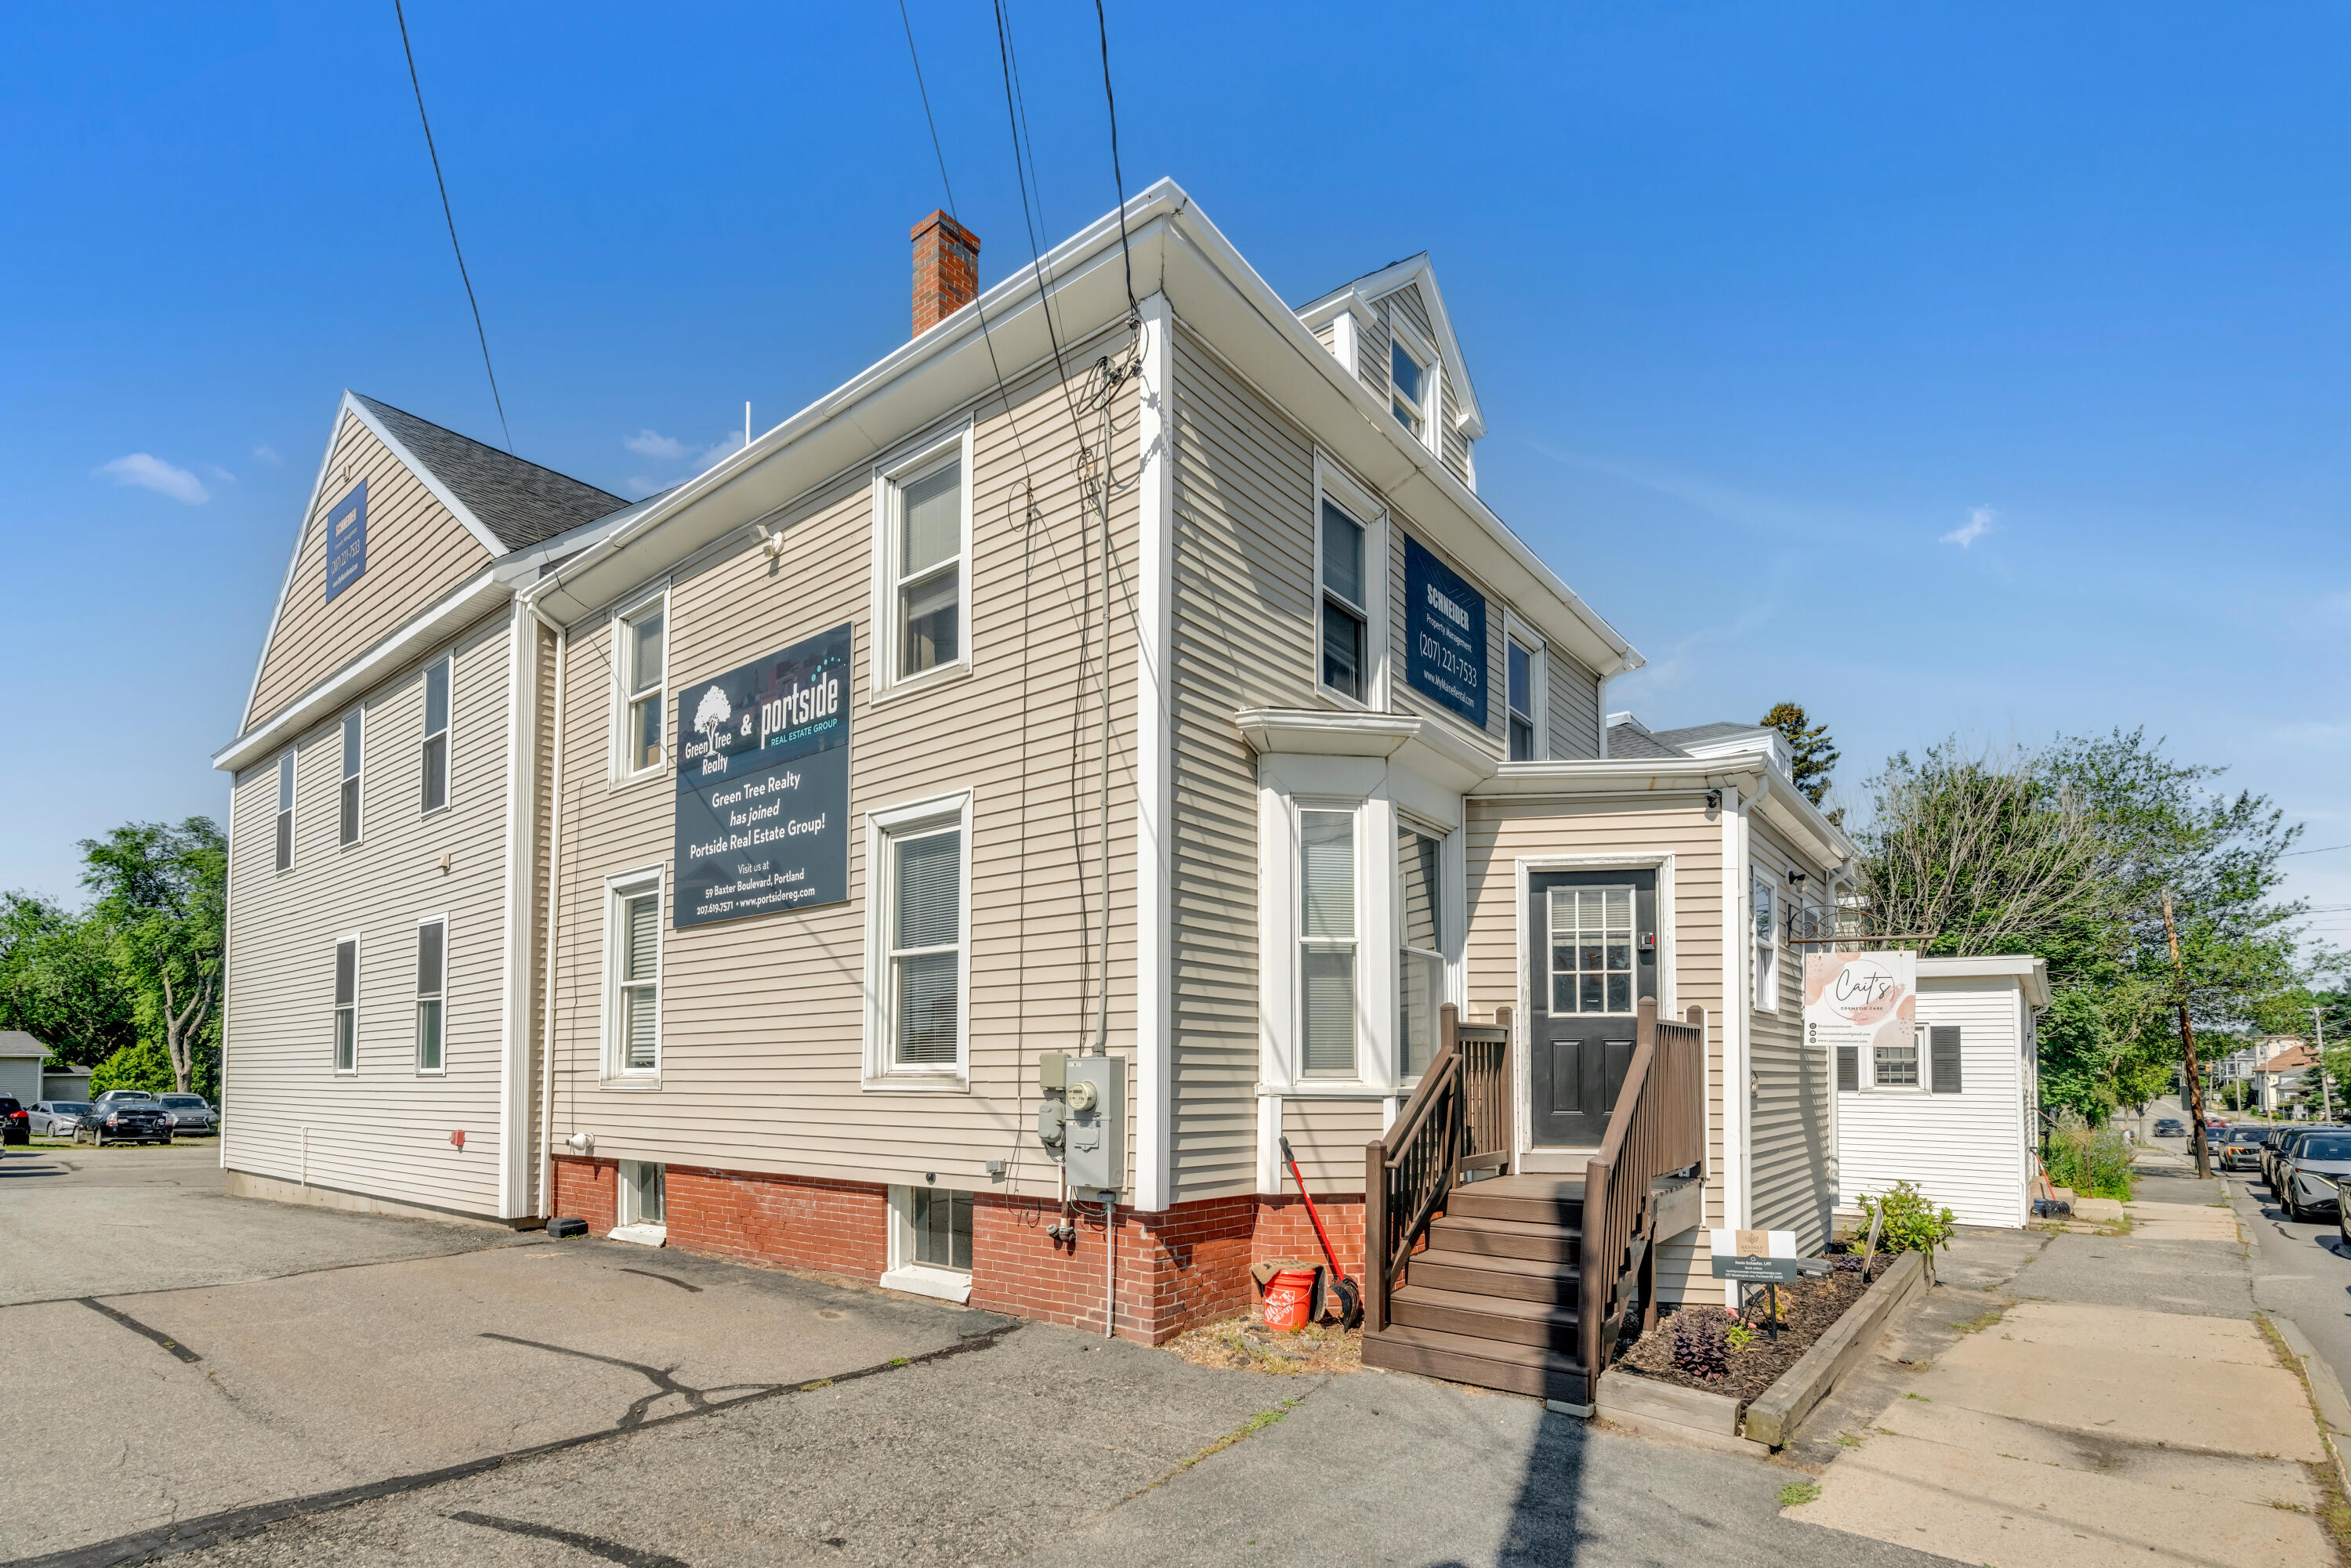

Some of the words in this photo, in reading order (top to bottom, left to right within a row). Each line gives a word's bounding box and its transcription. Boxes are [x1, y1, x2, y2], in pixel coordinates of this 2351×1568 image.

[1427, 583, 1469, 632] SCHNEIDER
[1426, 613, 1445, 636] Property
[1446, 627, 1473, 653] Management
[1419, 631, 1440, 667] (207)
[1442, 647, 1477, 688] 221-7533
[1424, 669, 1475, 708] www.MyMaineRental.com
[741, 714, 752, 736] &
[761, 672, 838, 750] portside
[685, 739, 708, 759] Green
[714, 731, 732, 751] Tree
[771, 733, 788, 747] REAL
[788, 725, 812, 741] ESTATE
[813, 718, 838, 735] GROUP
[702, 755, 728, 776] Realty
[712, 788, 741, 808] Green
[744, 782, 766, 800] Tree
[768, 771, 801, 795] Realty
[730, 809, 746, 827] has
[747, 798, 780, 827] joined
[690, 836, 728, 860] Portside
[730, 831, 752, 849] Real
[753, 822, 785, 845] Estate
[788, 813, 826, 839] Group!
[705, 887, 713, 899] 59
[714, 882, 736, 896] Baxter
[737, 876, 773, 892] Boulevard,
[773, 868, 804, 885] Portland
[737, 863, 752, 875] Visit
[754, 864, 763, 872] us
[763, 861, 770, 871] at
[697, 900, 734, 915] 207.619.7571
[740, 886, 815, 908] www.portsidereg.com
[1836, 969, 1893, 1004] Cait's
